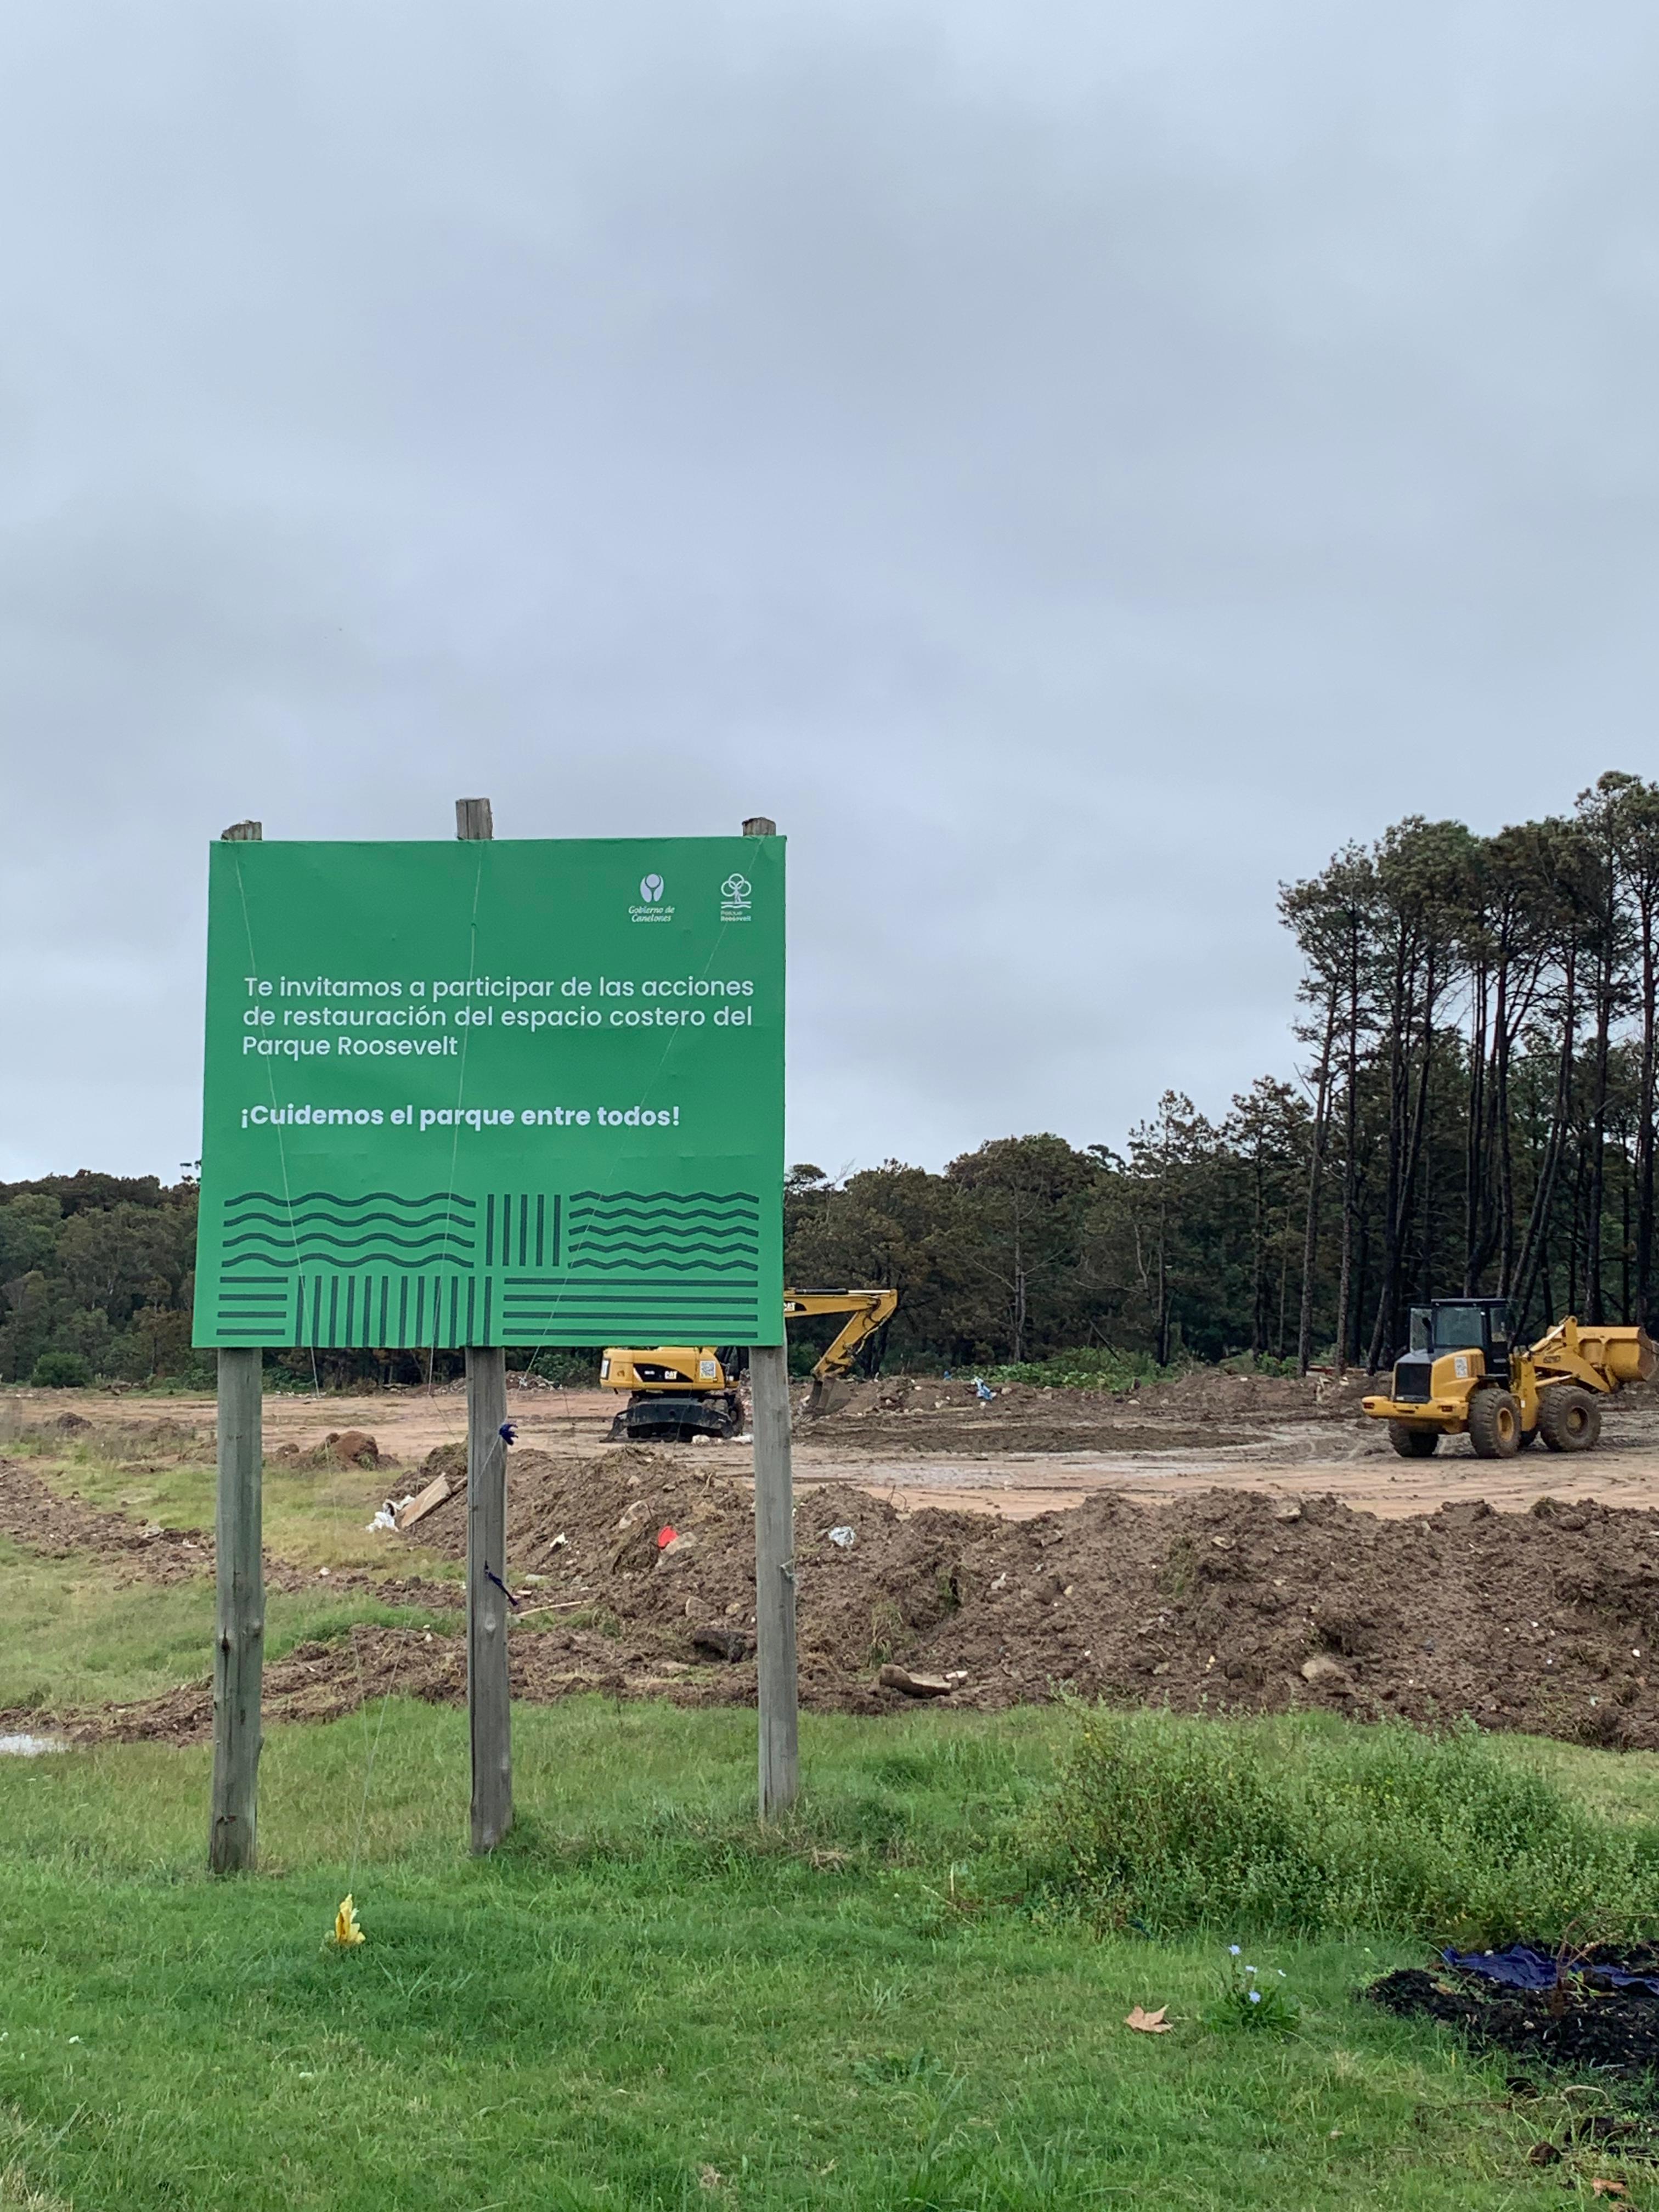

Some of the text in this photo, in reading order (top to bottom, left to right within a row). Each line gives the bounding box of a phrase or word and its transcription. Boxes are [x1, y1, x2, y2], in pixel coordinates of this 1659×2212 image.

[628, 906, 664, 914] Gobierno
[631, 913, 672, 922] Canelones
[244, 975, 754, 1003] Te invitamos a participar de las acciones
[243, 1005, 752, 1032] de restauración del espacio costero del
[243, 1035, 458, 1062] Parque Roosevelt
[241, 1103, 679, 1131] ¡Cuidemos el parque entre todos!
[664, 1370, 678, 1379] CAT
